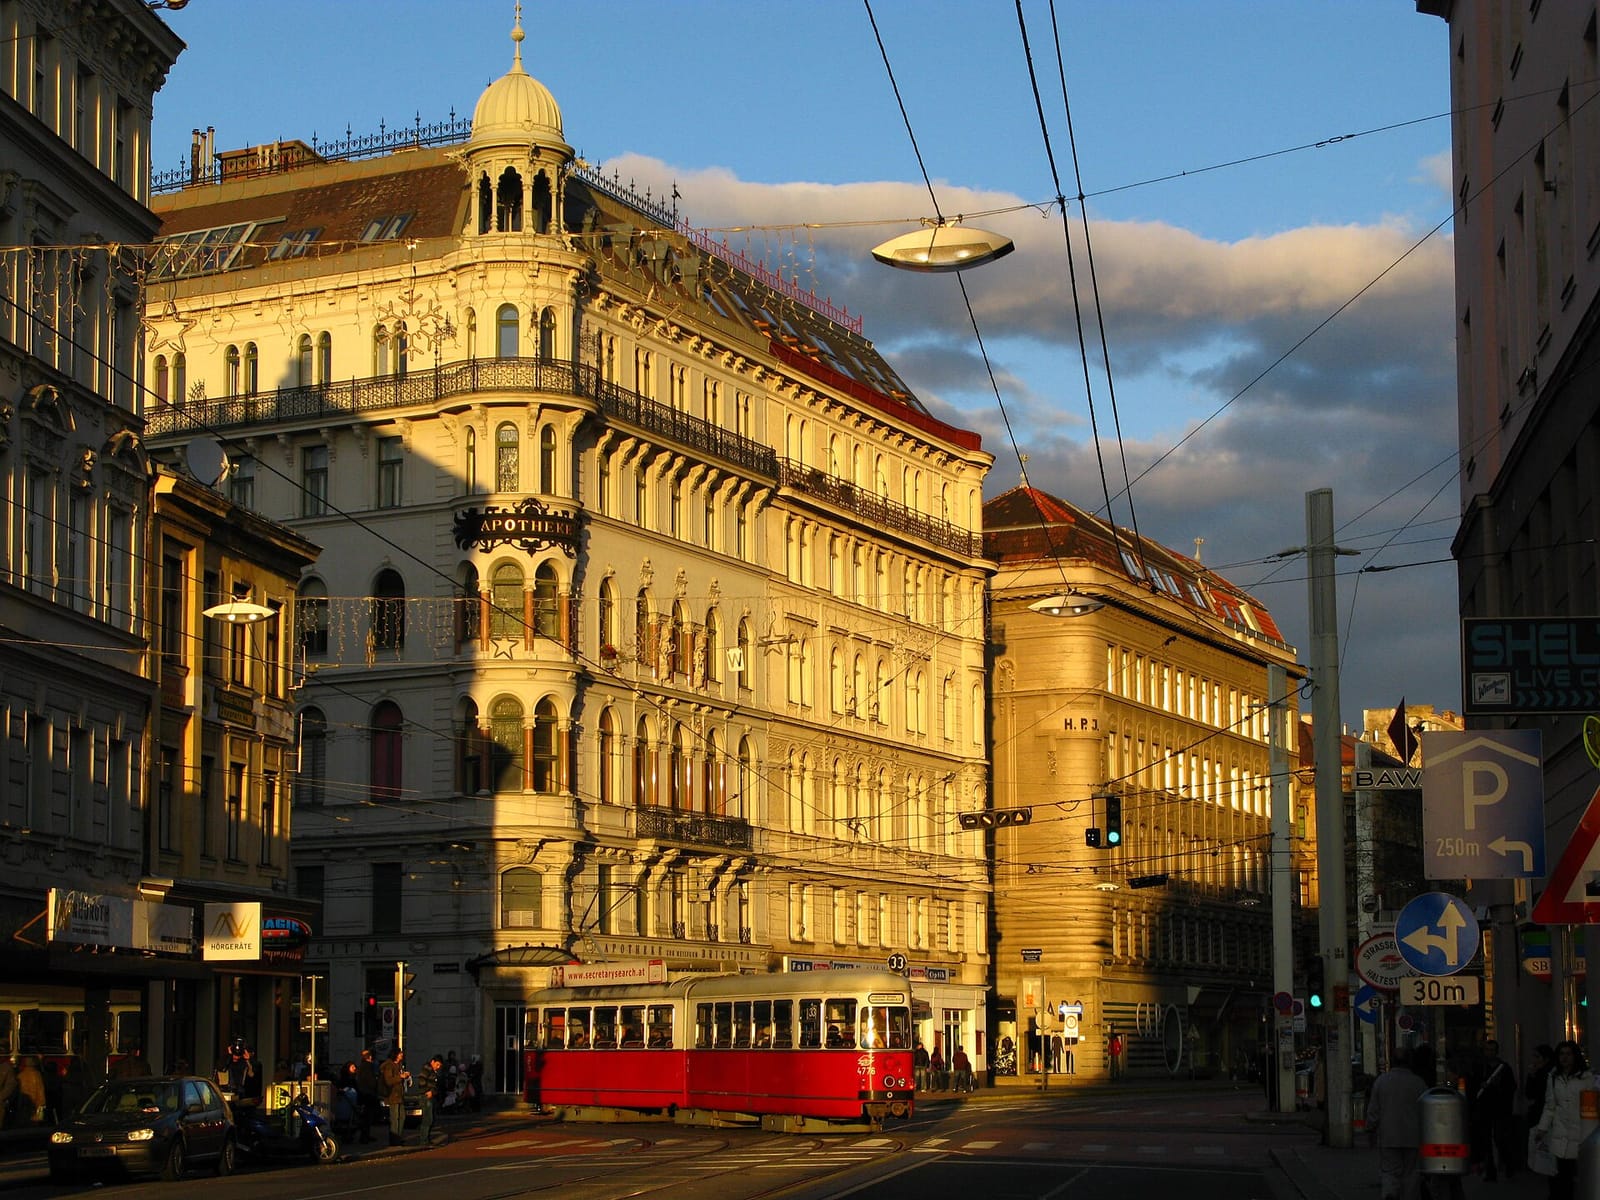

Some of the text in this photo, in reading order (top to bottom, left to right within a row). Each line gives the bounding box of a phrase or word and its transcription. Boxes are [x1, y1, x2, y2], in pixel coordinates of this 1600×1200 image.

[1471, 623, 1600, 667] SHEL
[727, 652, 742, 668] W
[1515, 668, 1600, 688] LIVE C
[1355, 769, 1424, 788] BAW
[1462, 760, 1509, 830] P
[1436, 837, 1479, 857] 250m
[211, 941, 253, 951] HÖRGERÄTE
[604, 943, 663, 956] APOTHEKE
[701, 948, 750, 961] BRIGITTA
[891, 956, 904, 969] 33
[568, 967, 645, 980] www.secretarysearch.at
[1413, 980, 1465, 1001] 30m
